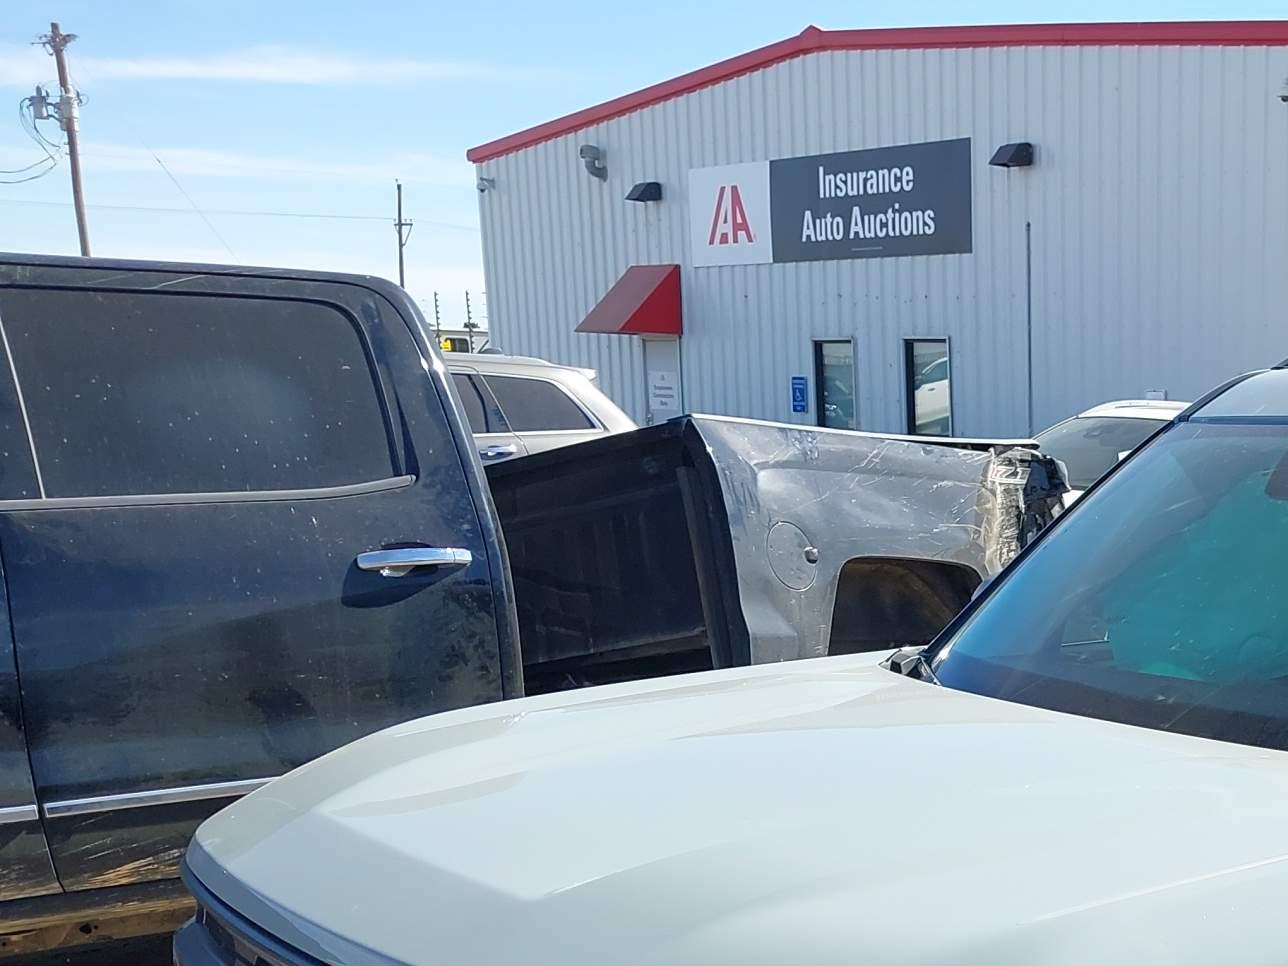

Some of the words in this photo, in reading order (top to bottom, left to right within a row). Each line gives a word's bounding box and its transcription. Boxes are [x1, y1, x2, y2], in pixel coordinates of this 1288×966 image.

[818, 165, 914, 199] Insurance
[801, 210, 844, 242] Auto
[849, 203, 935, 240] Auctions
